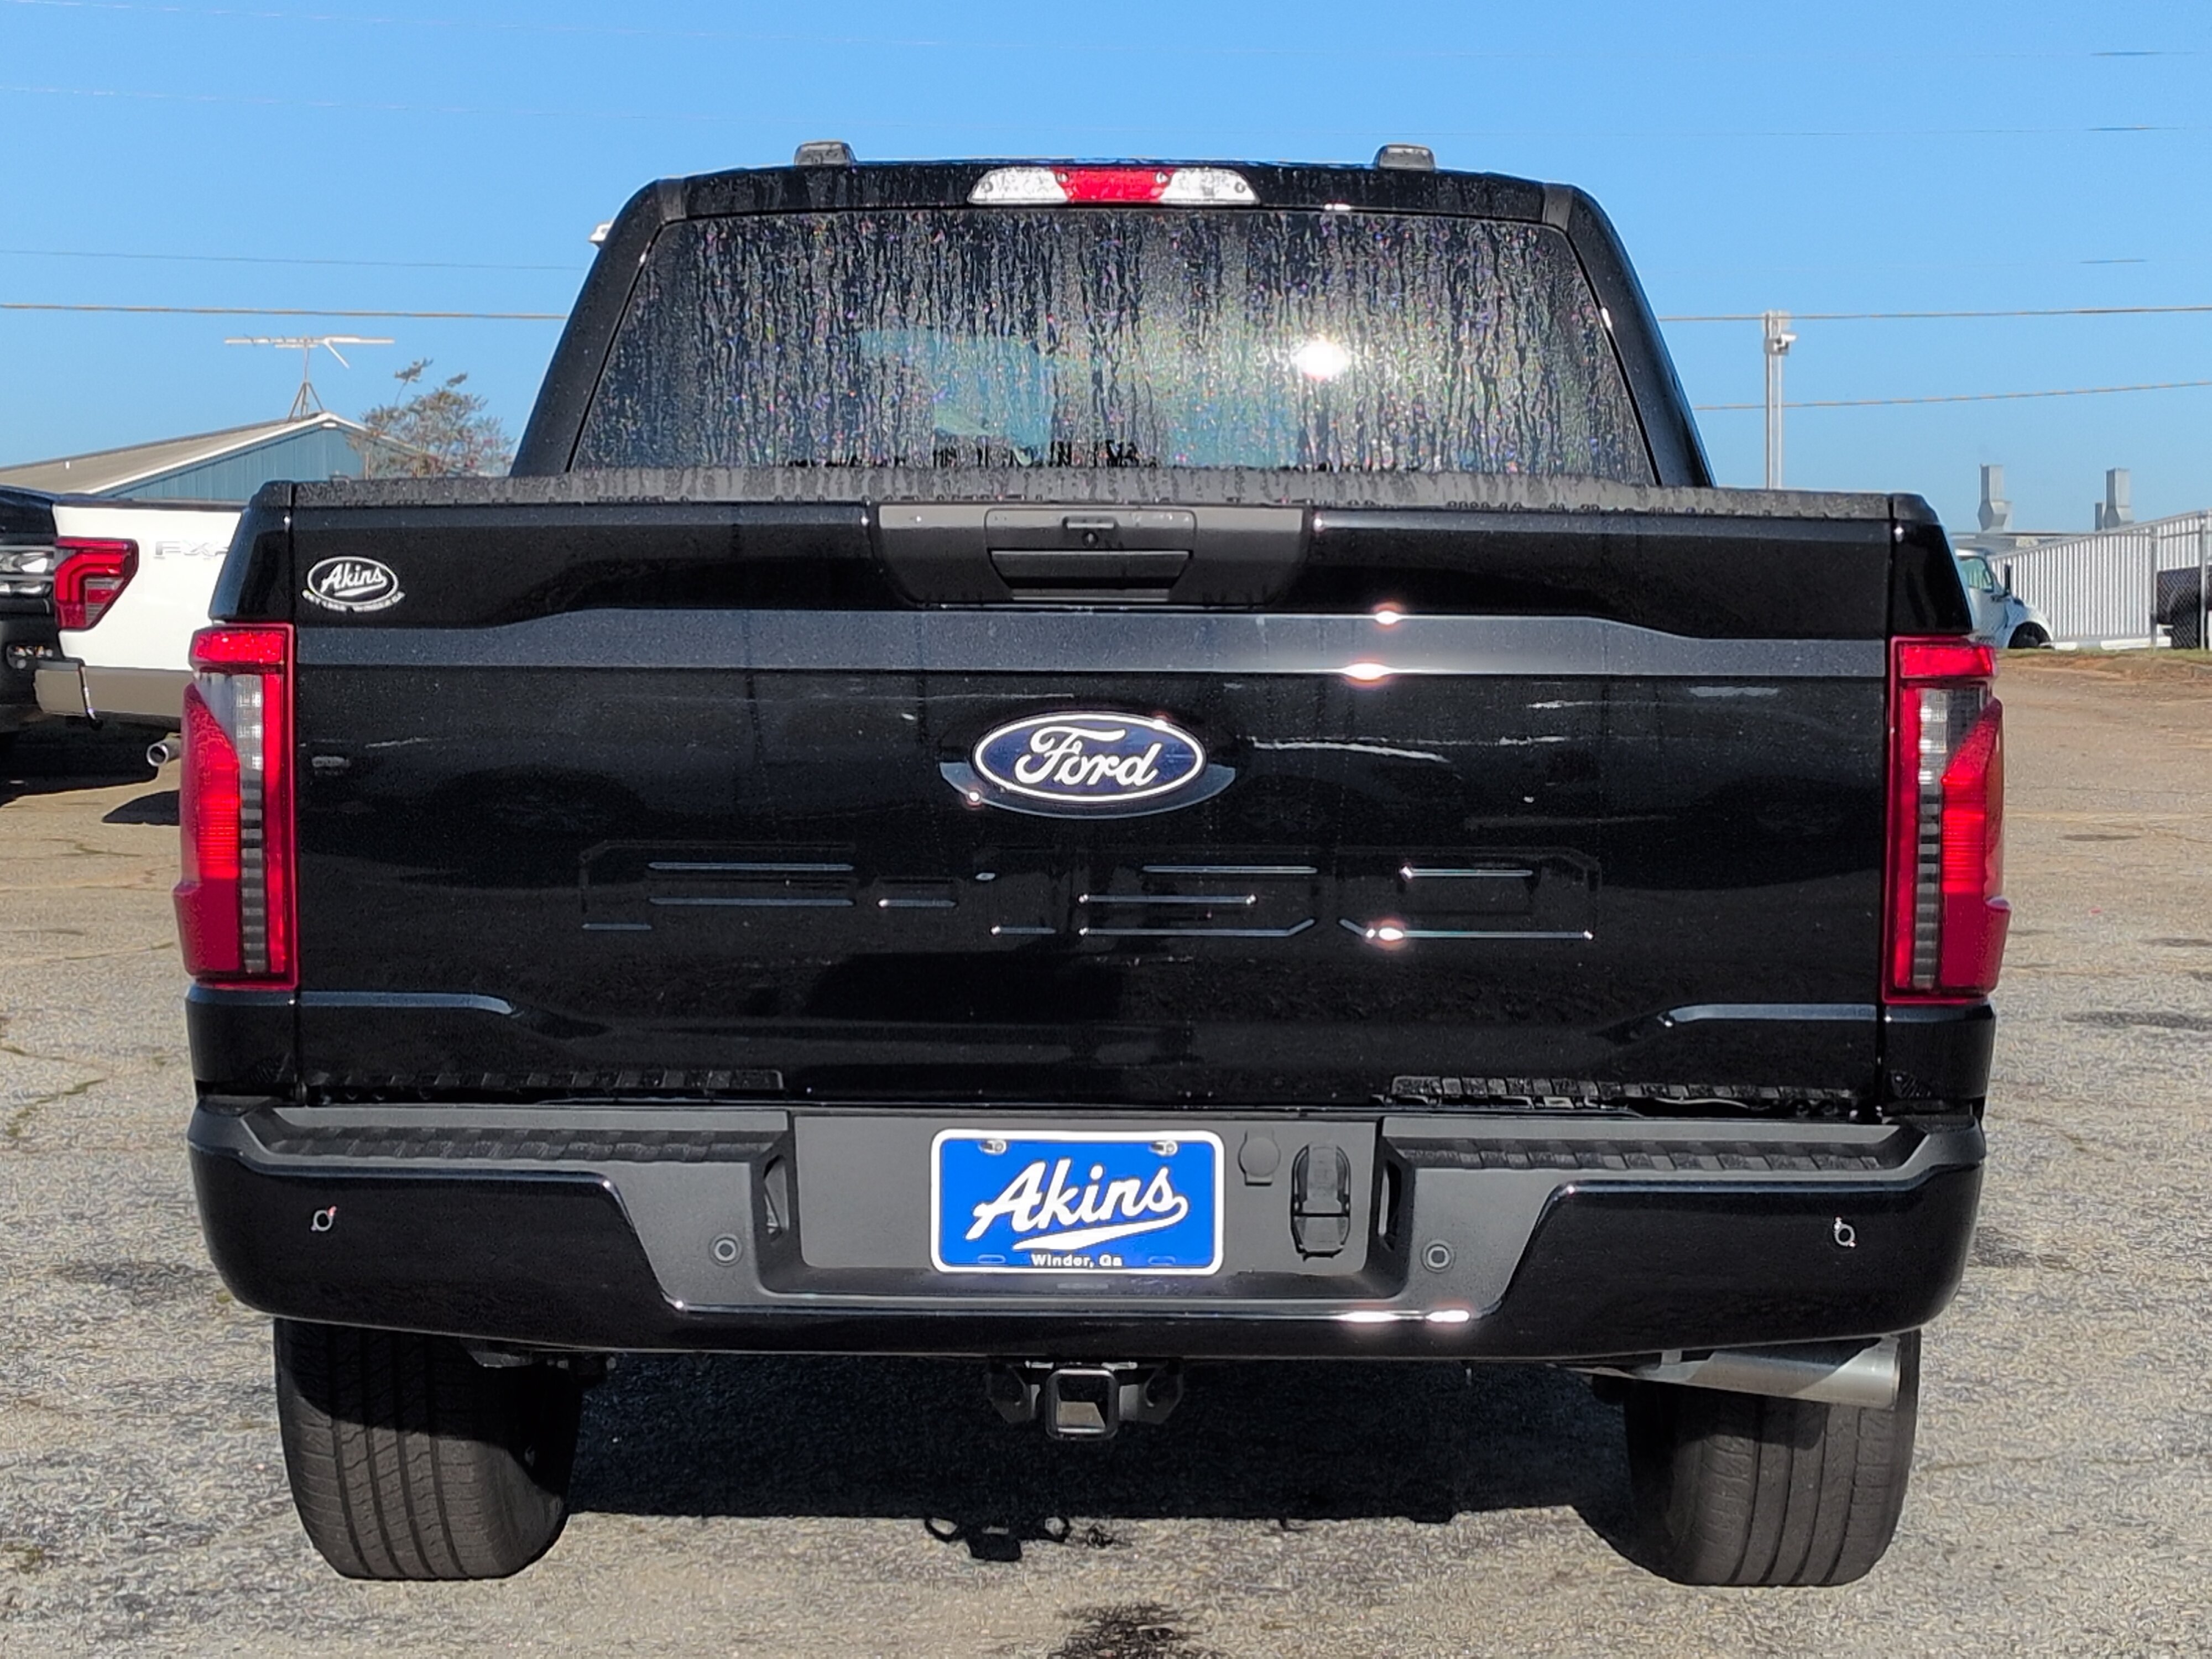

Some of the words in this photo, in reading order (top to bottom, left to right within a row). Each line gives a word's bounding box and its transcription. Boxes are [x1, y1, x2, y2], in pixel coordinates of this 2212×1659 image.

[320, 562, 386, 593] Akins
[1015, 726, 1161, 786] Ford
[966, 1158, 1181, 1241] Akins
[1031, 1254, 1094, 1267] Winder,
